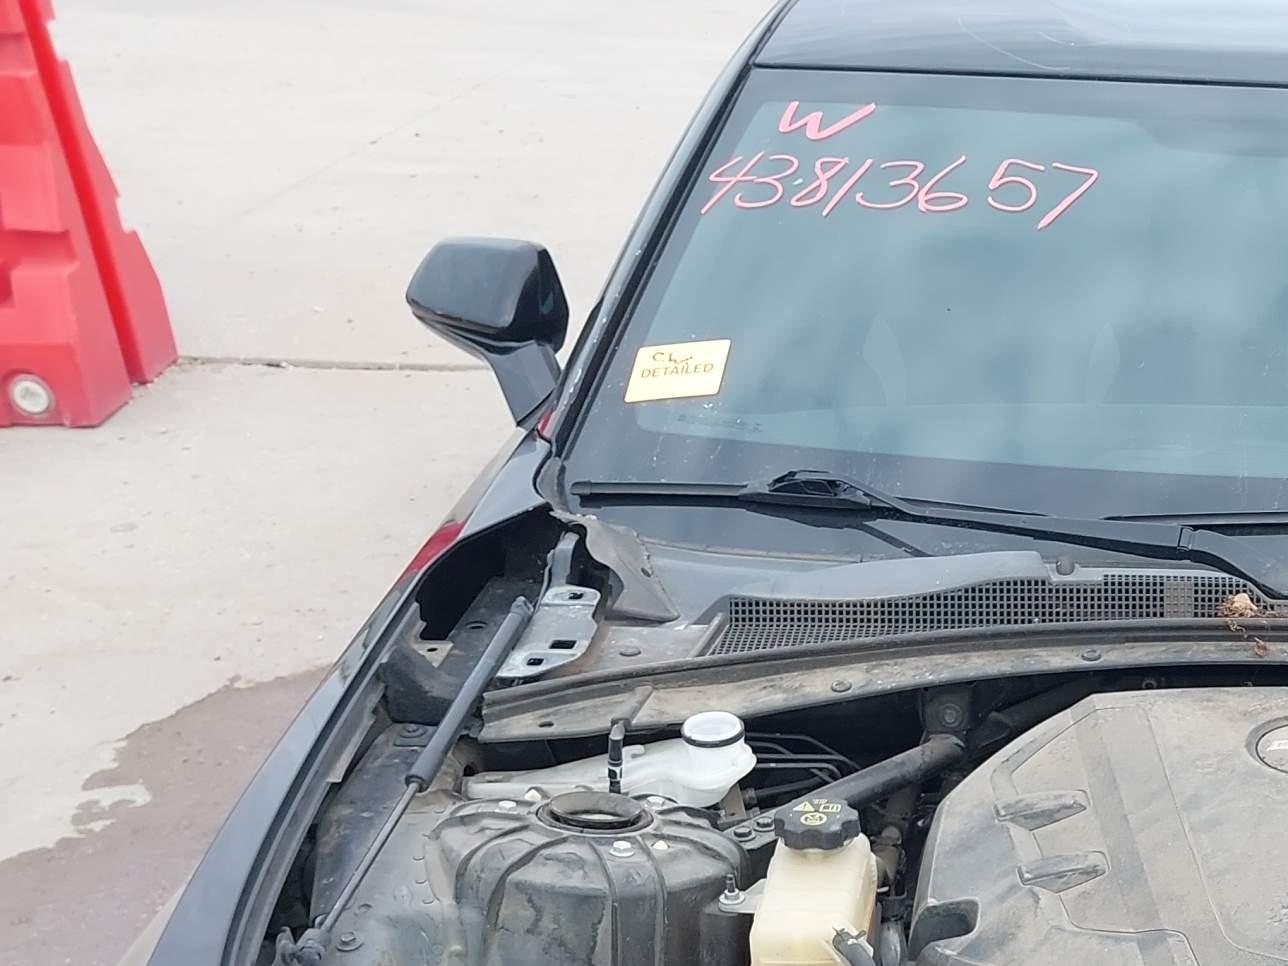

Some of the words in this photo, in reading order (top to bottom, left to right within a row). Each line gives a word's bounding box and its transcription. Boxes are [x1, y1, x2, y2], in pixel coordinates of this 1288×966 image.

[778, 100, 877, 140] W
[700, 151, 1099, 231] 43813657
[641, 363, 714, 378] DETAILED
